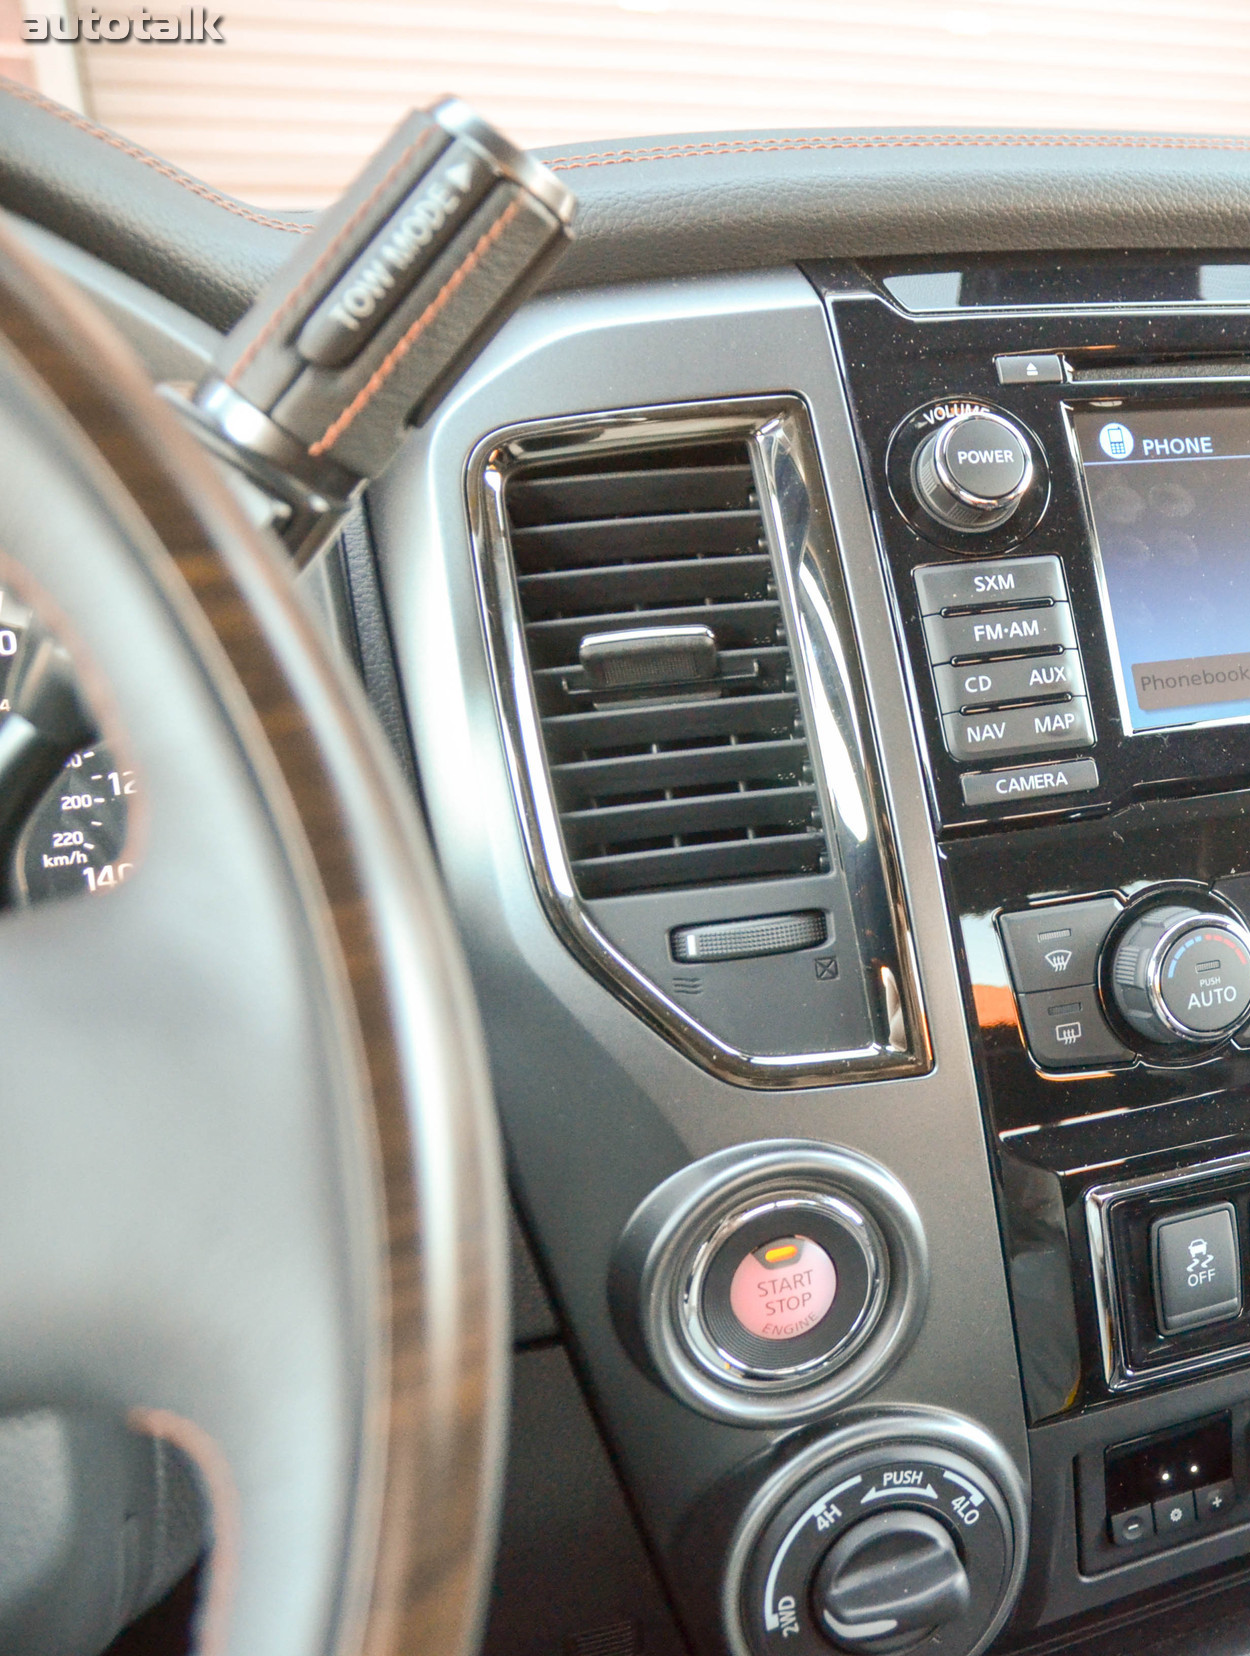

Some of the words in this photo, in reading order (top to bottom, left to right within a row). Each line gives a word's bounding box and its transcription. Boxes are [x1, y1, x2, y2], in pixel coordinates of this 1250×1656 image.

[329, 260, 395, 331] TOW
[382, 181, 461, 271] MODE
[1142, 436, 1213, 456] PHONE
[957, 449, 1014, 465] POWER
[974, 574, 1015, 592] SXM
[965, 674, 992, 693] CD
[1029, 666, 1067, 686] AUX
[1140, 665, 1250, 692] Phonebook
[966, 722, 1006, 743] NAV
[1034, 713, 1075, 734] MAP
[107, 771, 138, 796] 12
[995, 771, 1068, 794] CAMERA
[61, 794, 93, 810] 200
[52, 831, 84, 847] 220
[42, 850, 88, 868] km/h
[1199, 976, 1221, 988] PUSH
[1187, 985, 1237, 1011] AUTO
[757, 1268, 814, 1298] START
[1187, 1268, 1216, 1287] OFF
[764, 1291, 813, 1317] STOP
[761, 1311, 819, 1336] ENGINE
[882, 1469, 924, 1487] PUSH
[814, 1502, 843, 1532] 4H
[950, 1495, 980, 1526] 4LO
[780, 1594, 800, 1638] 2WD
